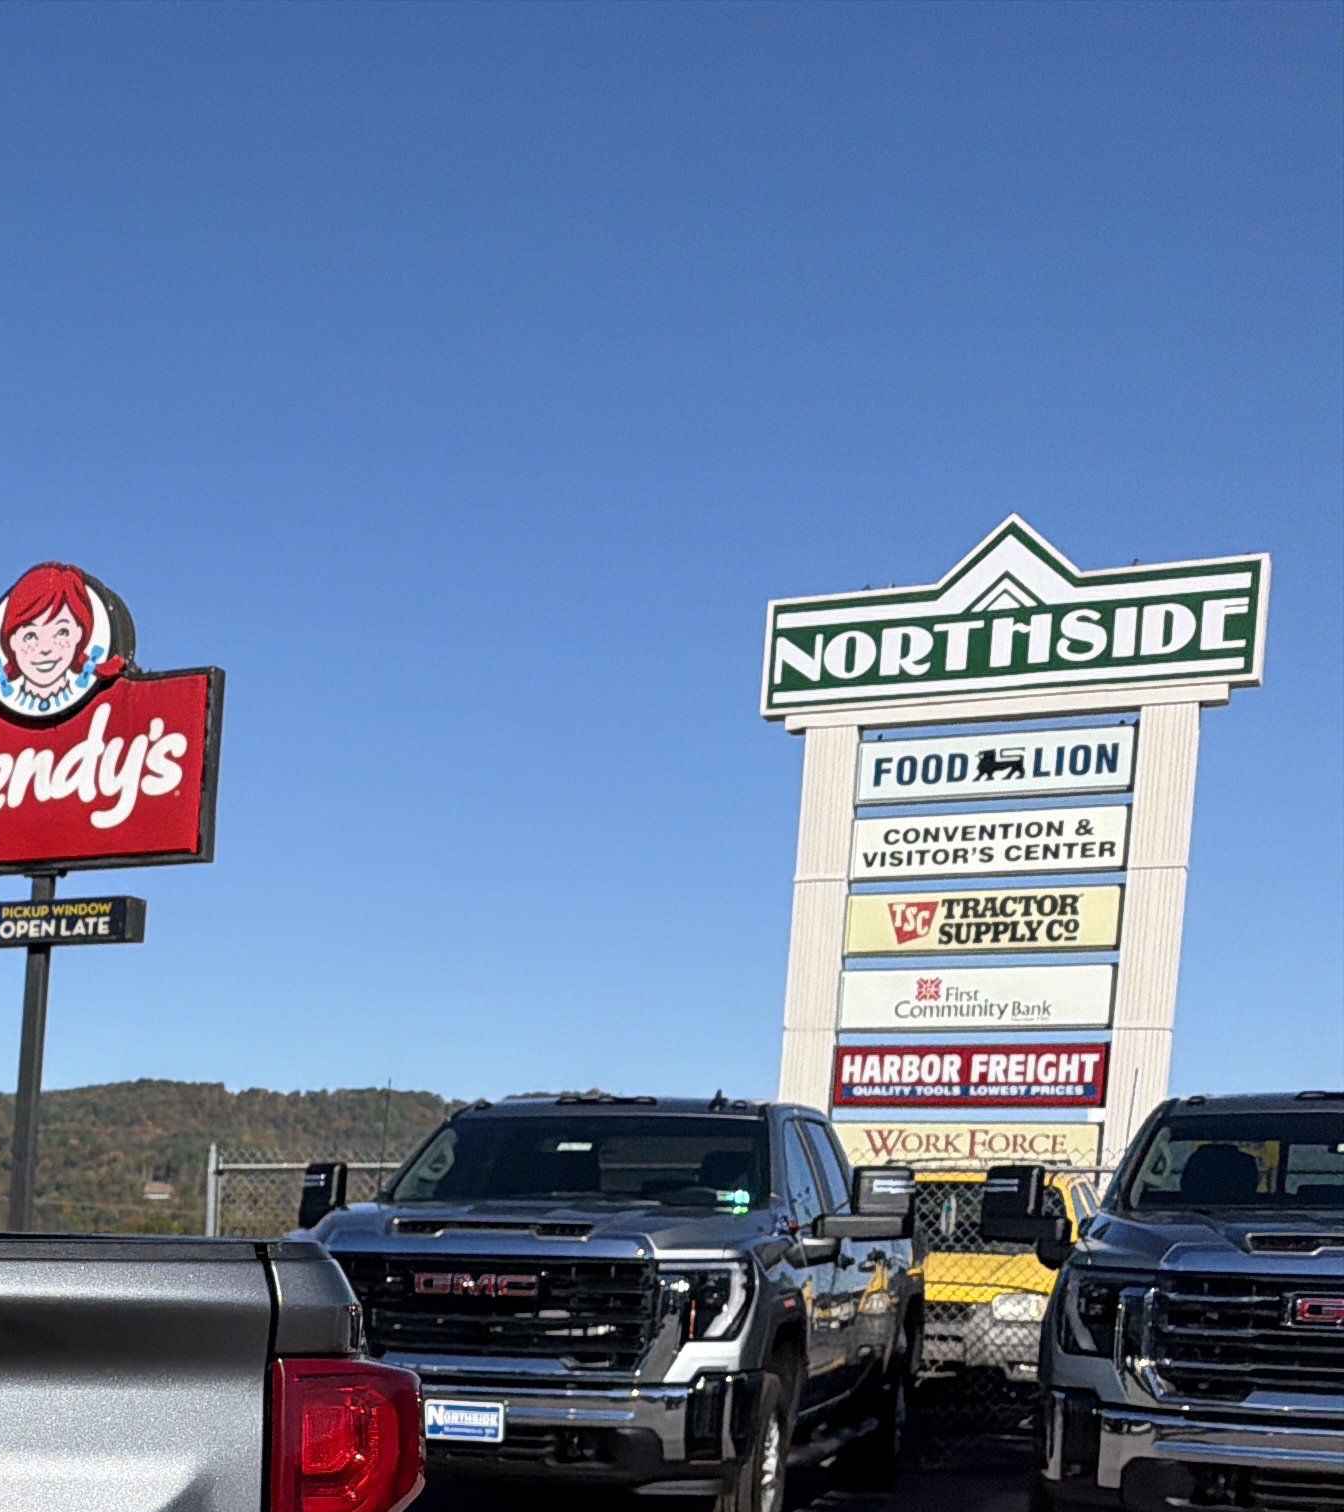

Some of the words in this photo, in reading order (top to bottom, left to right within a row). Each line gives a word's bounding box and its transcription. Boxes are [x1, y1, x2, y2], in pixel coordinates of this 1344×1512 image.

[773, 597, 1250, 684] NORTHSIDE
[873, 752, 968, 787] FOOD
[1032, 742, 1120, 778] LION
[883, 819, 1064, 846] CONVENTION
[1075, 817, 1095, 836] &
[862, 846, 994, 868] VISITOR'S
[1004, 840, 1117, 862] CENTER
[1, 904, 50, 919] PICKUP
[52, 902, 112, 917] WINDOW
[890, 903, 931, 937] TSC
[941, 894, 1080, 920] TRACTOR
[60, 916, 111, 937] LATE
[938, 919, 1044, 945] SUPPLY
[945, 986, 980, 1002] First
[894, 1000, 1009, 1020] Community
[1012, 1000, 1052, 1016] Bank
[841, 1054, 961, 1084] HARBOR
[969, 1053, 1101, 1083] FREIGHT
[852, 1086, 911, 1097] QUALITY
[916, 1086, 961, 1096] TOOLS
[969, 1085, 1026, 1096] LOWEST
[1031, 1085, 1084, 1096] PRICES
[414, 1272, 538, 1297] GMC
